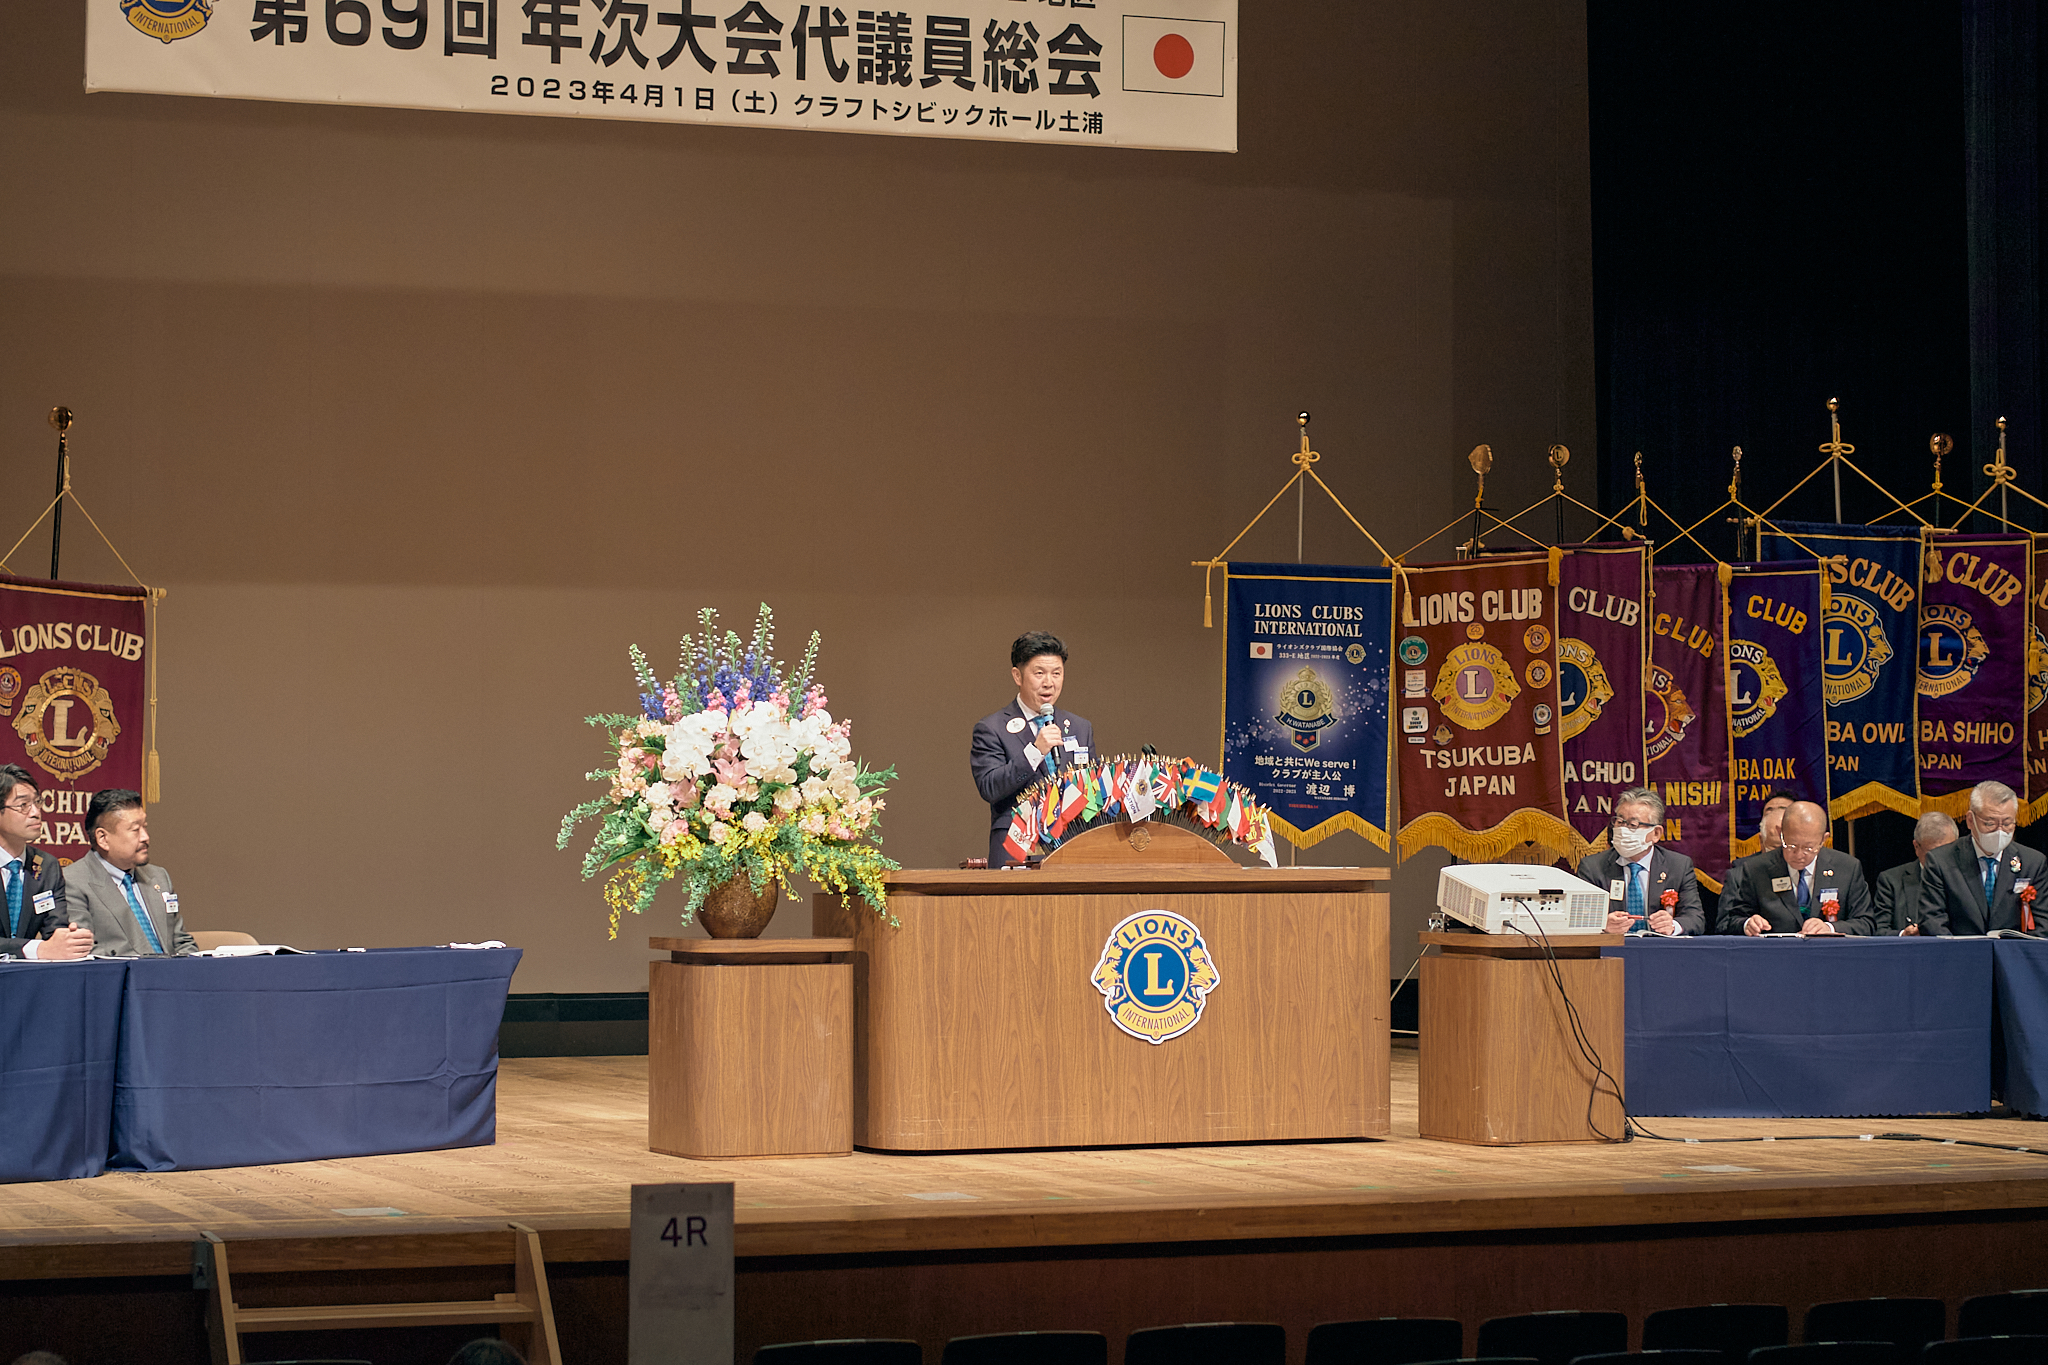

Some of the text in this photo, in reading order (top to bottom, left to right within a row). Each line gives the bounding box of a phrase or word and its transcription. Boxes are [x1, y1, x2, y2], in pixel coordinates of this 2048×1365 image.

[133, 11, 201, 34] INTERNATIONAL
[793, 93, 1104, 136] クラフトシビックホール土浦
[1849, 557, 1916, 613] CLUB
[1946, 551, 2022, 607] CLUB
[1254, 603, 1364, 622] LIONS CLUBS
[1481, 588, 1543, 622] CLUB
[1568, 586, 1641, 627] CLUB
[1747, 594, 1808, 635] CLUB
[0, 622, 145, 662] LIONS CLUB
[1254, 620, 1363, 638] INTERNATIONAL
[1654, 612, 1715, 659] CLUB
[1454, 648, 1498, 665] LIONS
[1825, 628, 1853, 667] L
[1927, 632, 1954, 667] L
[1463, 670, 1488, 699] L
[49, 699, 89, 747] L
[1286, 717, 1326, 728] H.WATANABE
[1451, 704, 1501, 721] INTERNATIONAL
[1918, 720, 1949, 742] BA
[1953, 721, 2015, 745] SHIHO
[1420, 742, 1537, 769] TSUKUBA
[1763, 757, 1797, 780] OAK
[1272, 768, 1342, 782] クラブが主人公
[1582, 759, 1636, 785] CHUO
[1445, 775, 1517, 798] JAPAN
[1665, 780, 1722, 806] NISHI
[27, 821, 91, 846] APA
[1121, 918, 1191, 945] LIONS
[1143, 952, 1175, 996] L
[1122, 1007, 1191, 1030] INTERNATIONAL
[660, 1215, 708, 1248] 4R
